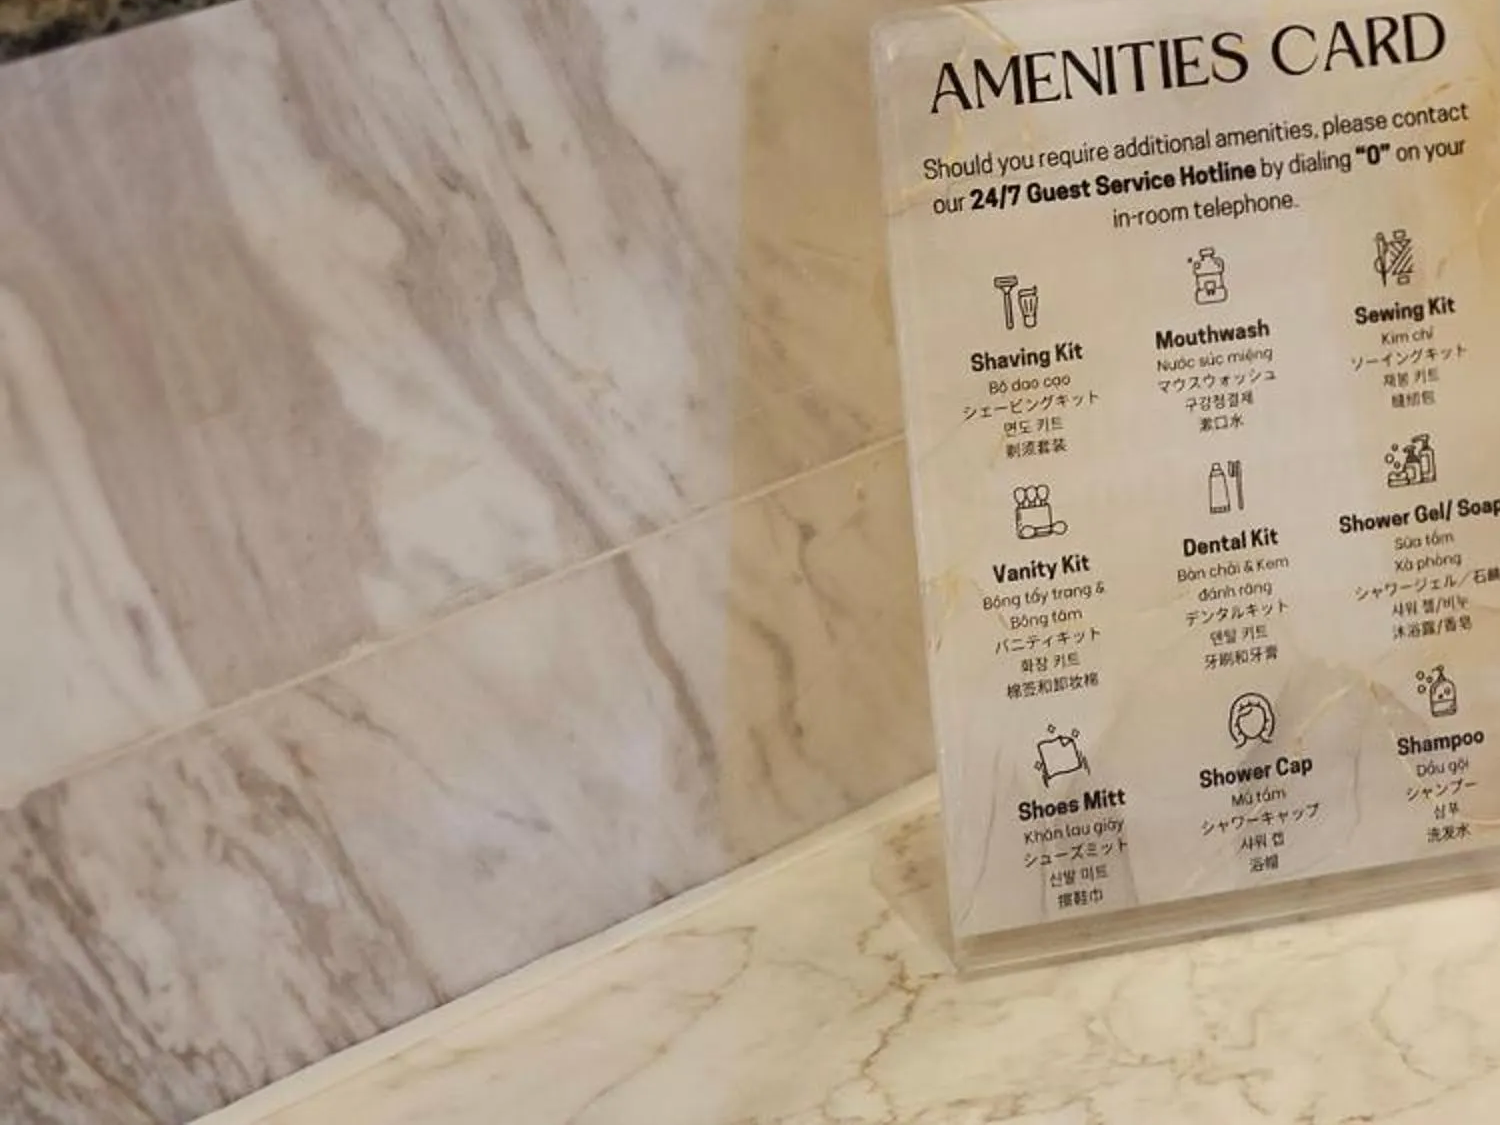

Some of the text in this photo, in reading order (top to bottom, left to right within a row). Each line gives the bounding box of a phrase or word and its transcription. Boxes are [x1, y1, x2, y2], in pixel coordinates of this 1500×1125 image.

[931, 11, 1447, 114] AMENITIES CARD
[924, 102, 1469, 180] Should you require additional amenities, please contact
[933, 196, 966, 214] our
[970, 184, 1021, 210] 24/7
[1027, 178, 1091, 204] Guest
[1096, 170, 1176, 196] Service
[1180, 160, 1257, 187] Hotline
[1260, 157, 1285, 181] by
[1289, 150, 1352, 174] dialing
[1396, 145, 1420, 163] on
[1424, 139, 1465, 163] your
[1113, 192, 1300, 228] in-room telephone.
[1354, 296, 1456, 325] Sewing Kit
[1155, 318, 1270, 350] Mouthwash
[1381, 332, 1409, 345] Kim
[971, 342, 1083, 372] Shaving Kit
[1011, 378, 1039, 392] dao
[1339, 511, 1410, 534] Shower
[1414, 499, 1453, 524] Gel/
[1183, 526, 1279, 557] Dental Kit
[993, 554, 1090, 583] Vanity Kit
[1244, 559, 1254, 573] &
[1256, 557, 1289, 571] Kem
[1051, 585, 1092, 600] trang
[1096, 581, 1105, 594] &
[1397, 730, 1485, 756] Shampoo
[1199, 756, 1313, 789] Shower Cap
[1018, 788, 1126, 822] Shoes Mitt
[1065, 824, 1091, 838] lau
